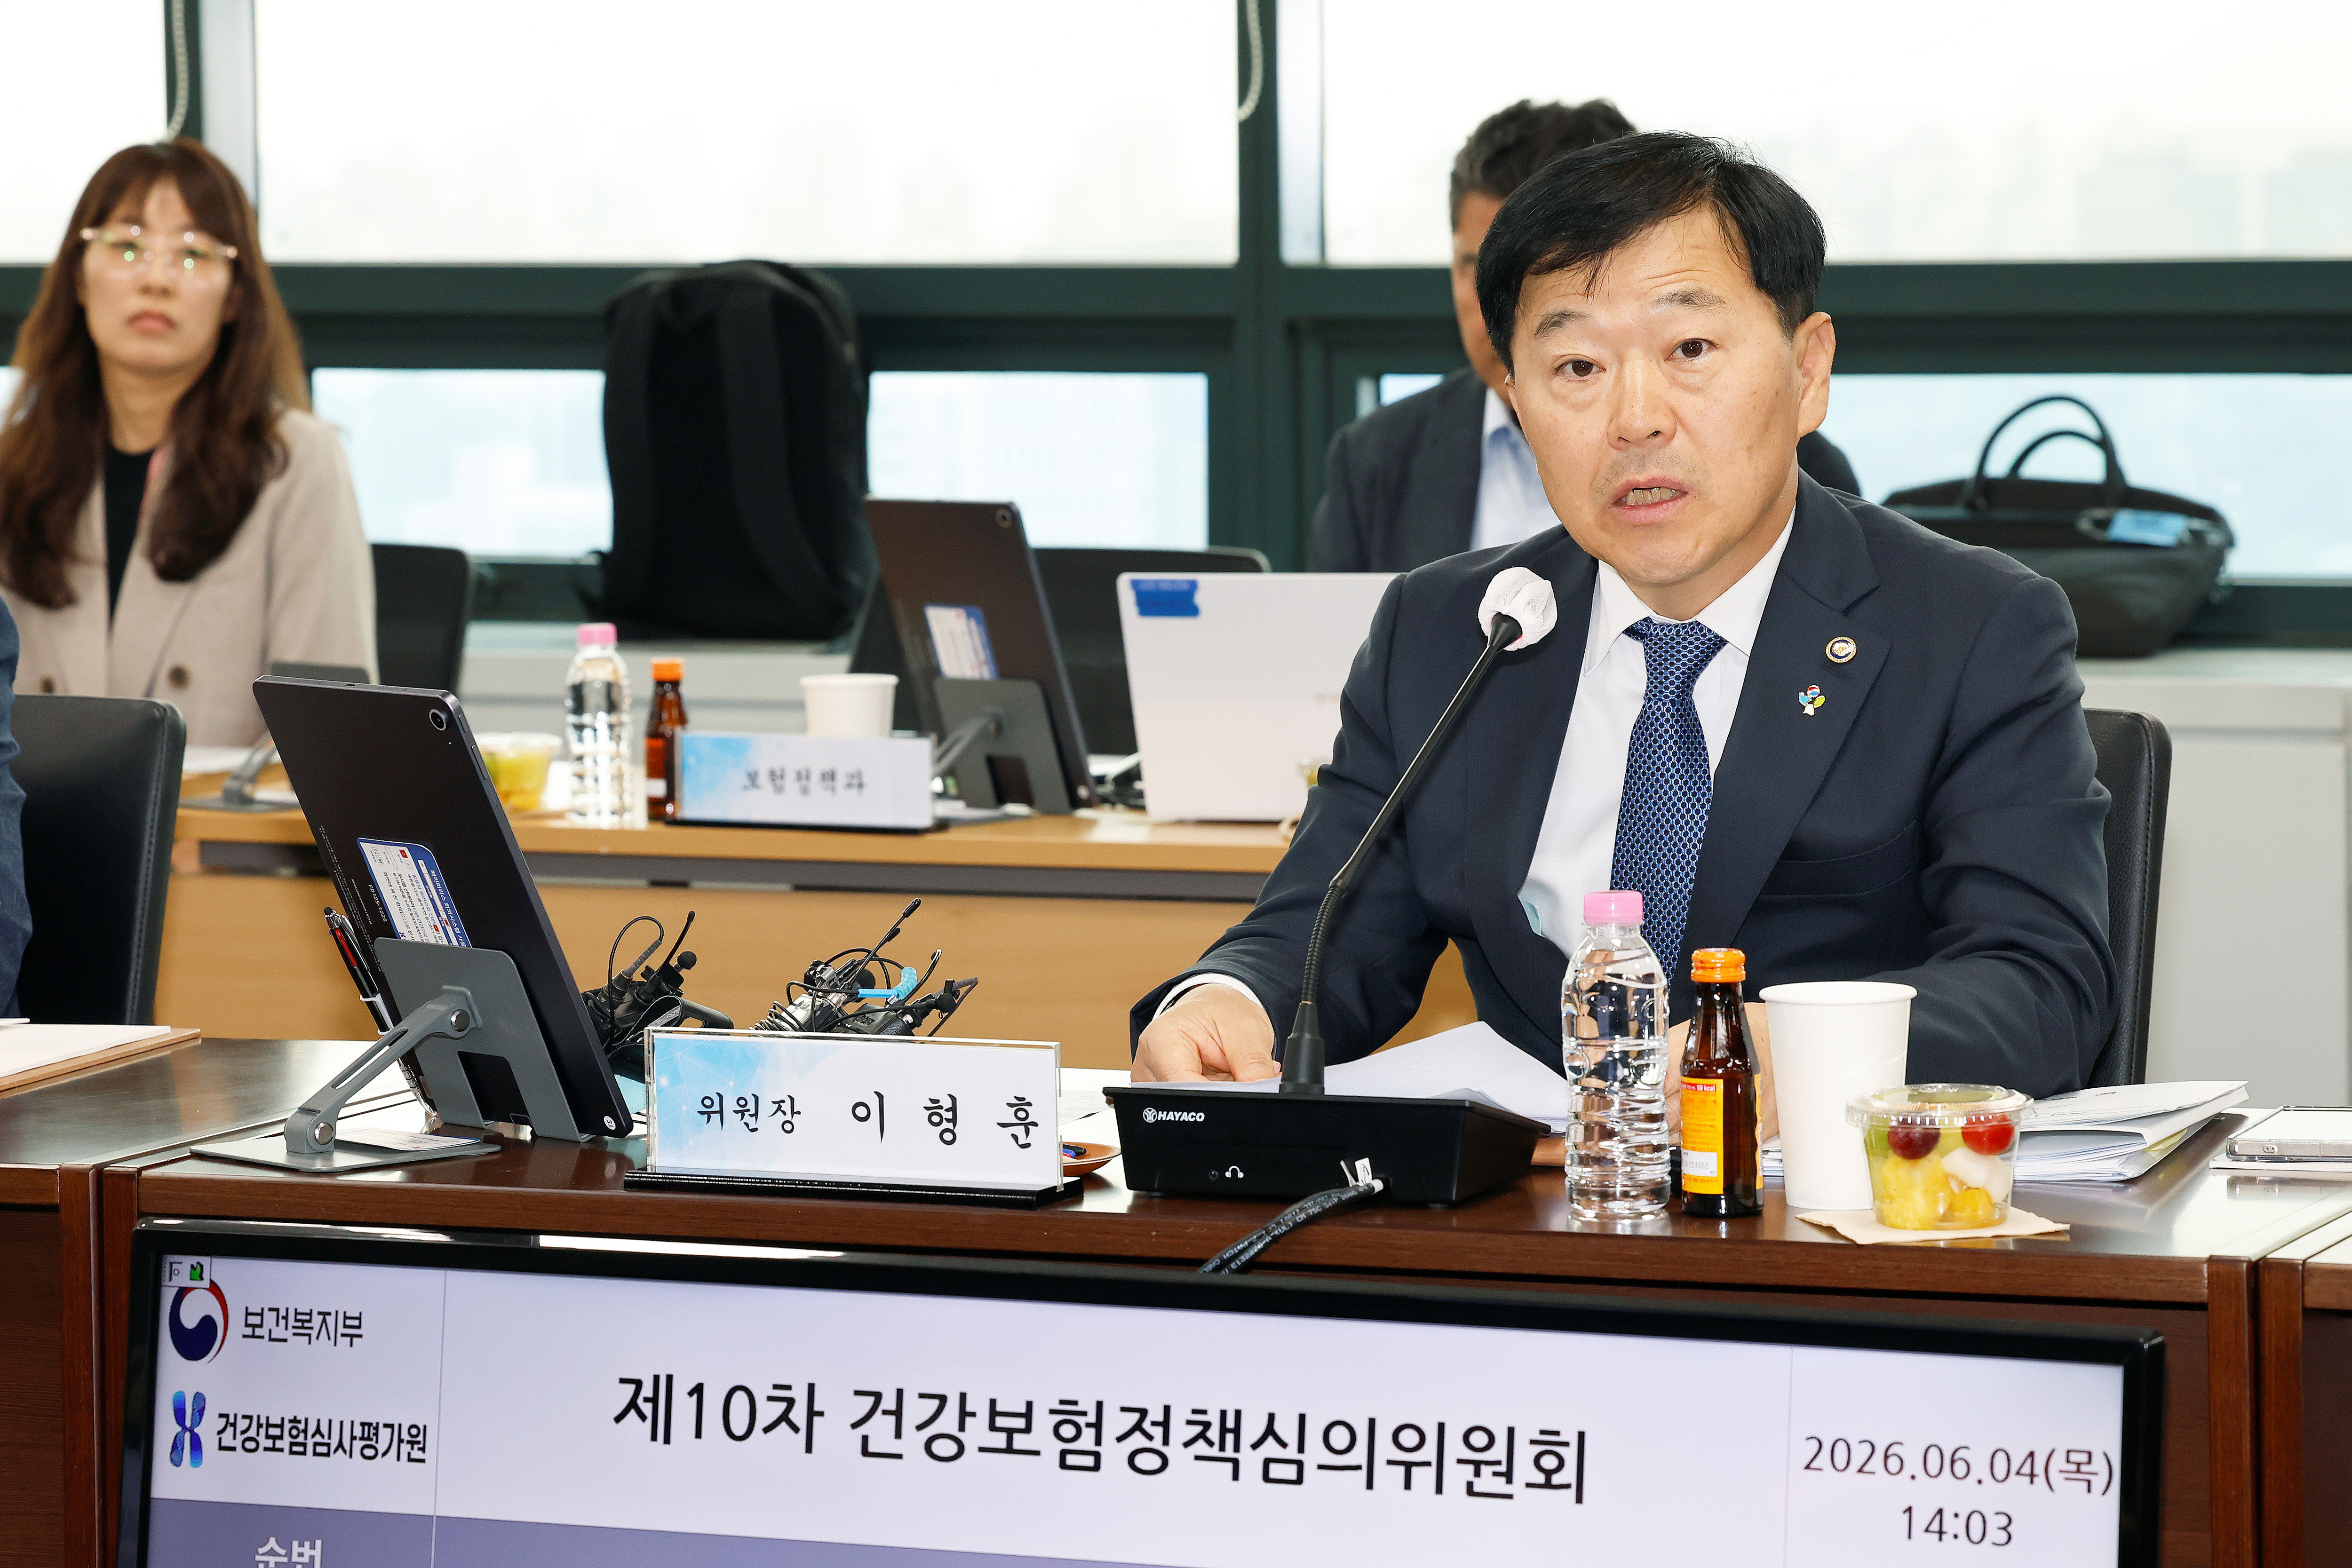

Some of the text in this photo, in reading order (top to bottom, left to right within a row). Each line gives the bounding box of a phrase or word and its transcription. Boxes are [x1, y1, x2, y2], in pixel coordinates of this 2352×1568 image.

[443, 903, 461, 934] 회의시스템
[697, 1092, 801, 1134] 위원장
[1158, 1110, 1205, 1122] HAYACO
[242, 1306, 363, 1347] 보건복지부
[216, 1412, 427, 1463] 건강보험심사평가원
[613, 1373, 1586, 1505] 제10차 건강보험정책심의위원회
[1803, 1435, 2114, 1496] 2026.06.04(목)
[1902, 1505, 2013, 1547] 14:03
